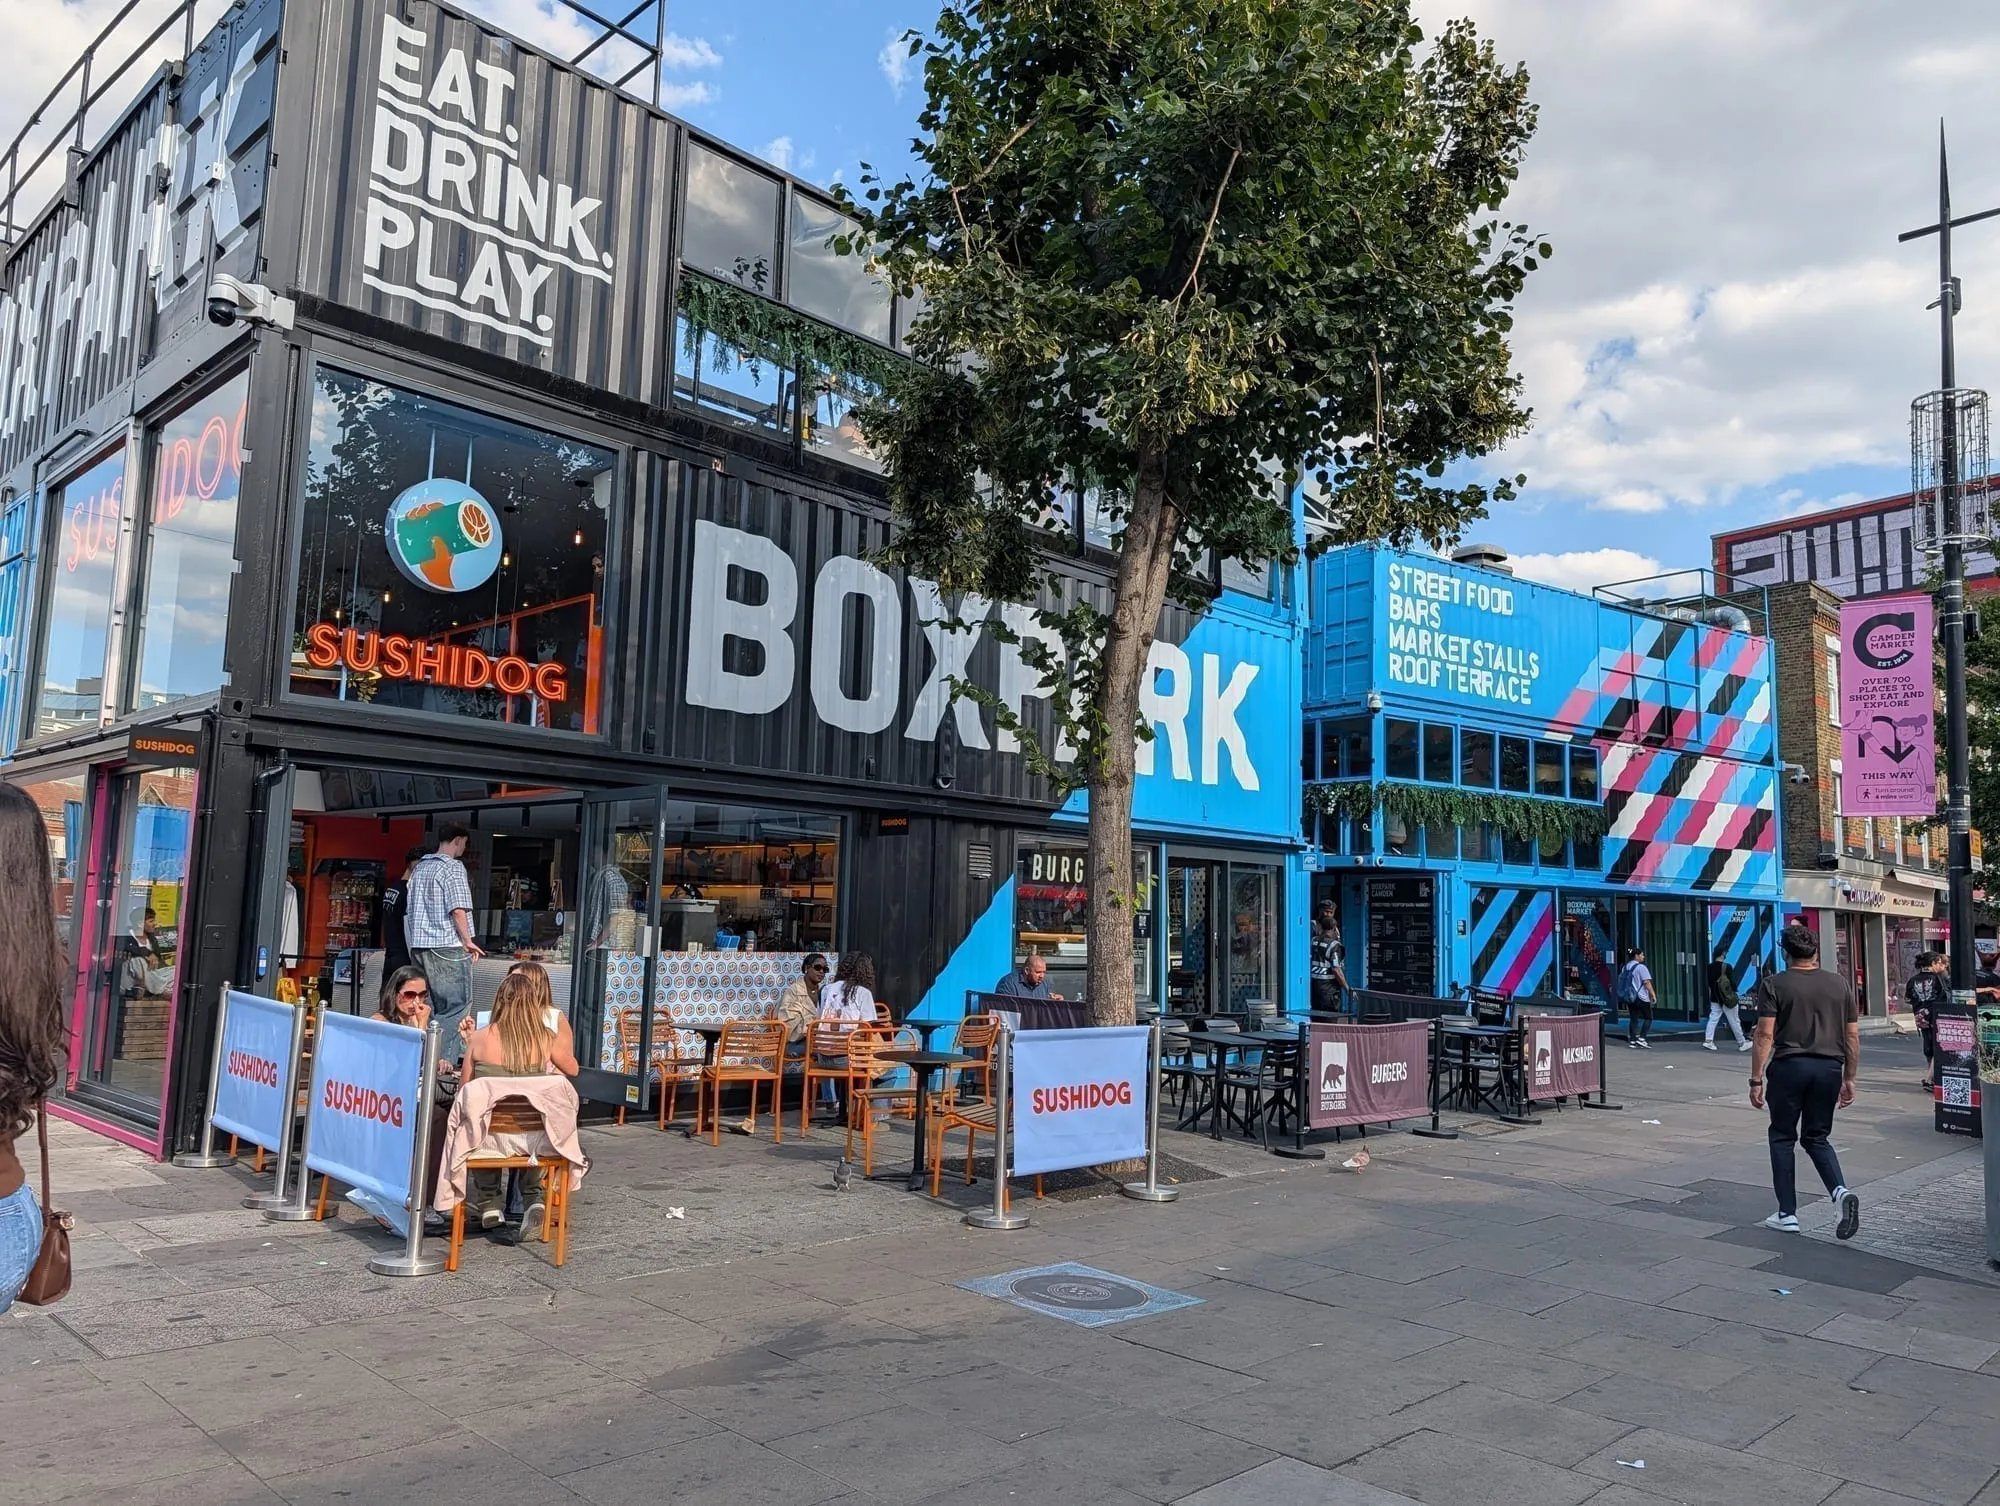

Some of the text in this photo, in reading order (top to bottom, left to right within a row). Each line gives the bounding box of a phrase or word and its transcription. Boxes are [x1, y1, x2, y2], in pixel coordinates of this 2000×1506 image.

[379, 14, 519, 143] EAT.
[372, 105, 614, 269] DRINK.
[364, 195, 554, 332] PLAY.
[1389, 562, 1514, 616] STREET FOOD
[1389, 592, 1441, 629] BARS
[1389, 622, 1540, 679] MARKET STALLS
[1870, 632, 1915, 642] CAMDEN
[1870, 640, 1915, 649] MARKET
[307, 623, 567, 702] SUSHIDOG
[686, 519, 1260, 791] BOXPRK
[1389, 652, 1531, 705] ROOF TERRACE
[1859, 685, 1898, 693] PLACES
[1863, 700, 1910, 708] EXPLORE
[135, 739, 195, 755] SUSHIDOG
[1862, 771, 1914, 780] THIS WAY
[1032, 853, 1085, 883] BURG
[1567, 901, 1596, 909] BOXPARK
[1938, 1035, 1972, 1043] HOUSE
[1940, 1028, 1972, 1036] DISCO
[227, 1050, 278, 1089] SUSHIDOG
[1371, 1062, 1408, 1084] BURGERS
[324, 1079, 403, 1127] SUSHIDOG
[1032, 1081, 1132, 1115] SUSHIDOG
[1320, 1101, 1346, 1111] BURGER
[1321, 1093, 1335, 1101] BLACK
